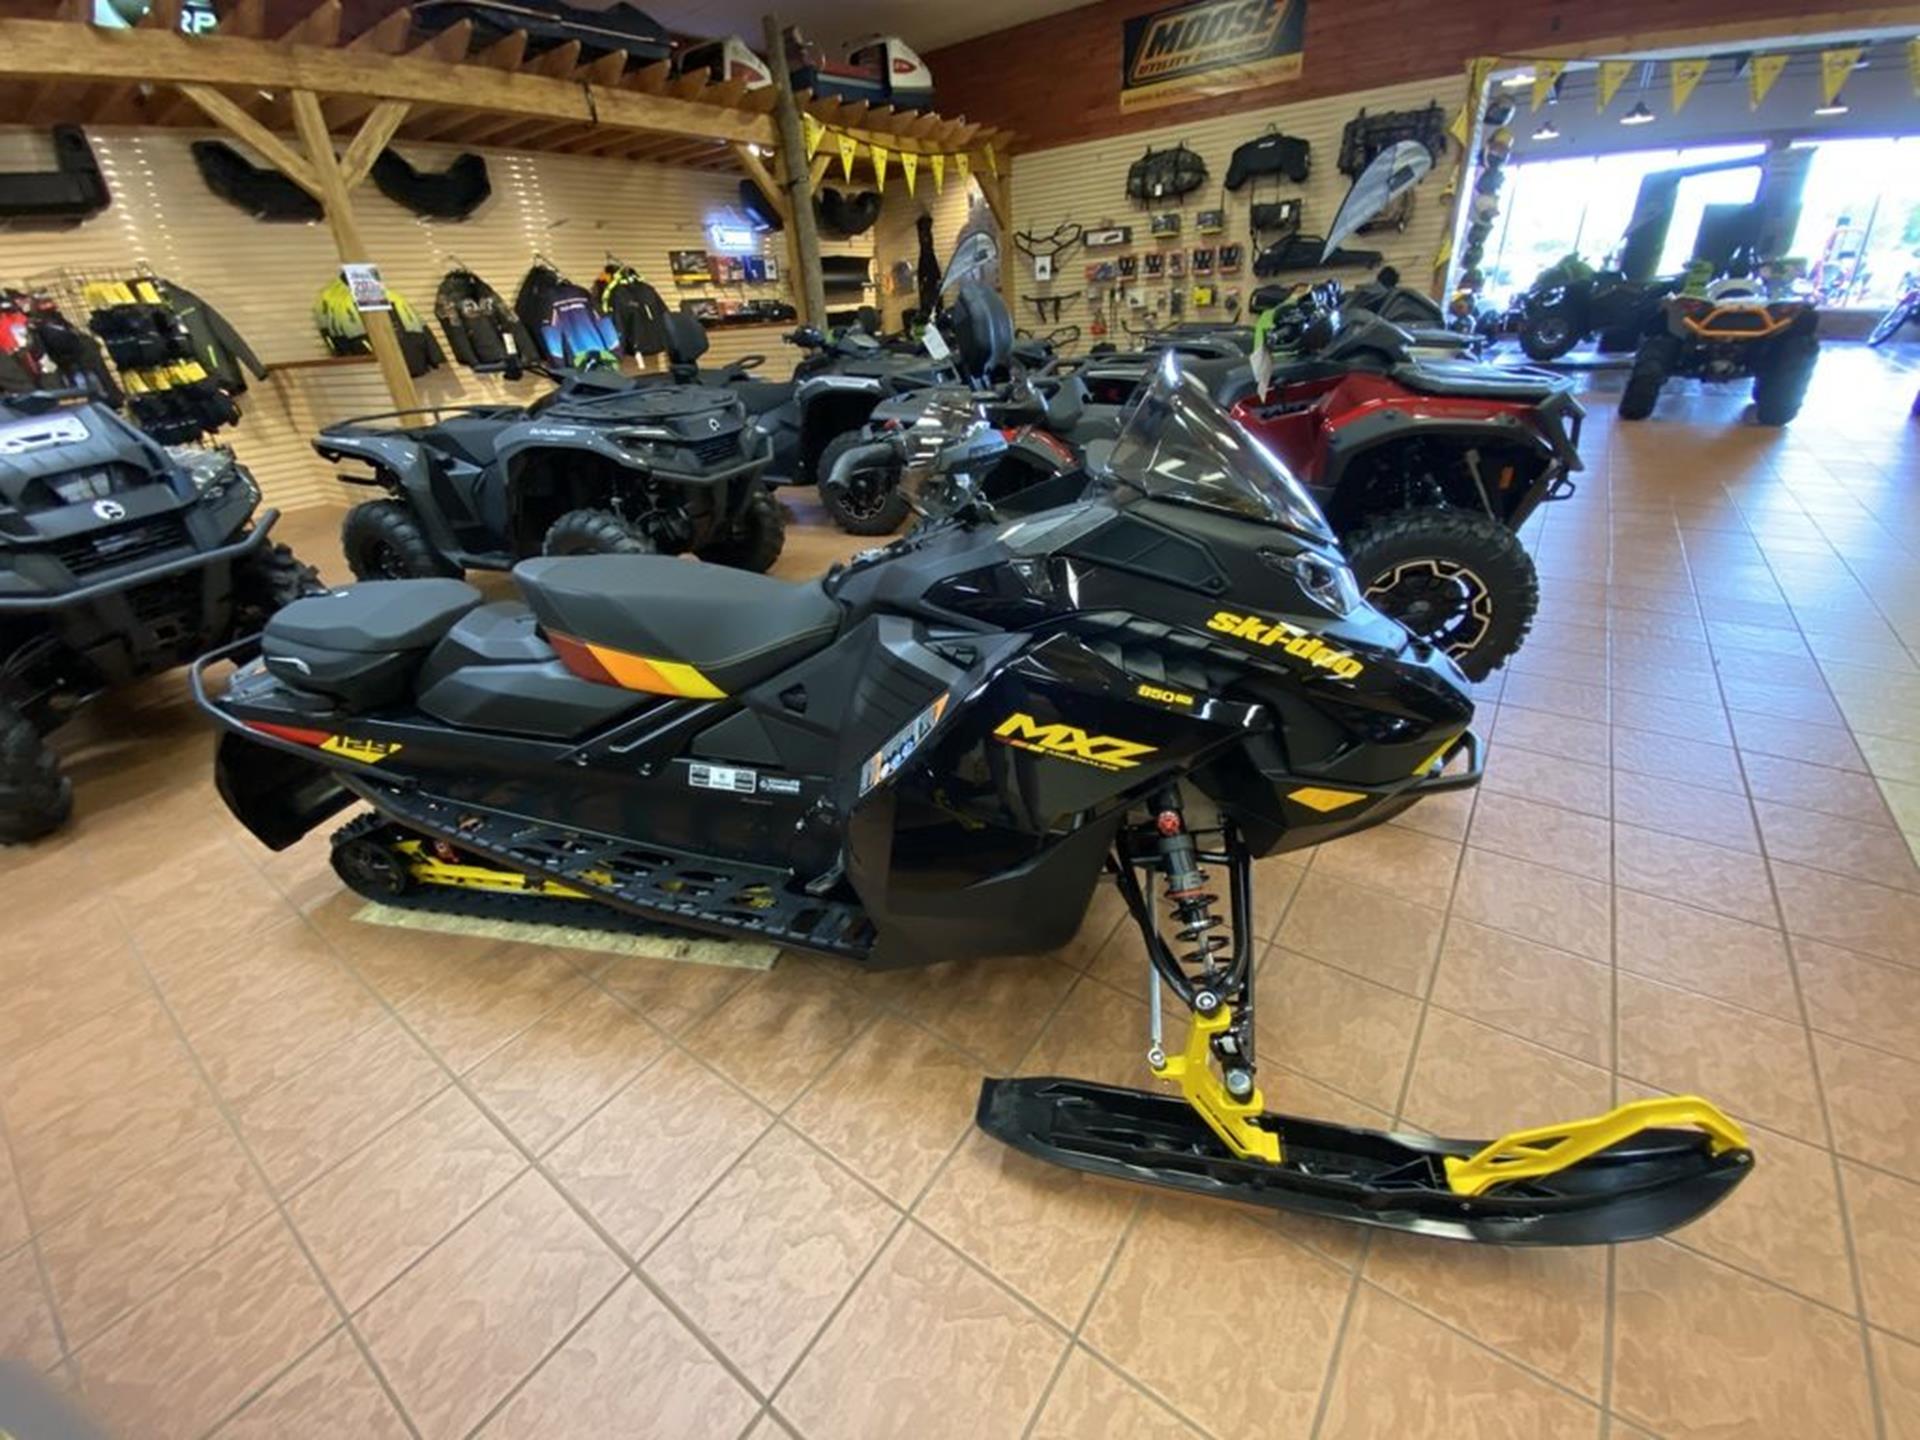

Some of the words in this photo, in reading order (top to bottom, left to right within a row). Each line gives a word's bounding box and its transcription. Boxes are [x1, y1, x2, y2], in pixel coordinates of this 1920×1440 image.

[1145, 0, 1284, 59] MOOSE
[1206, 611, 1364, 679] ski-doo
[1138, 684, 1174, 702] 850
[993, 713, 1158, 768] MXZ
